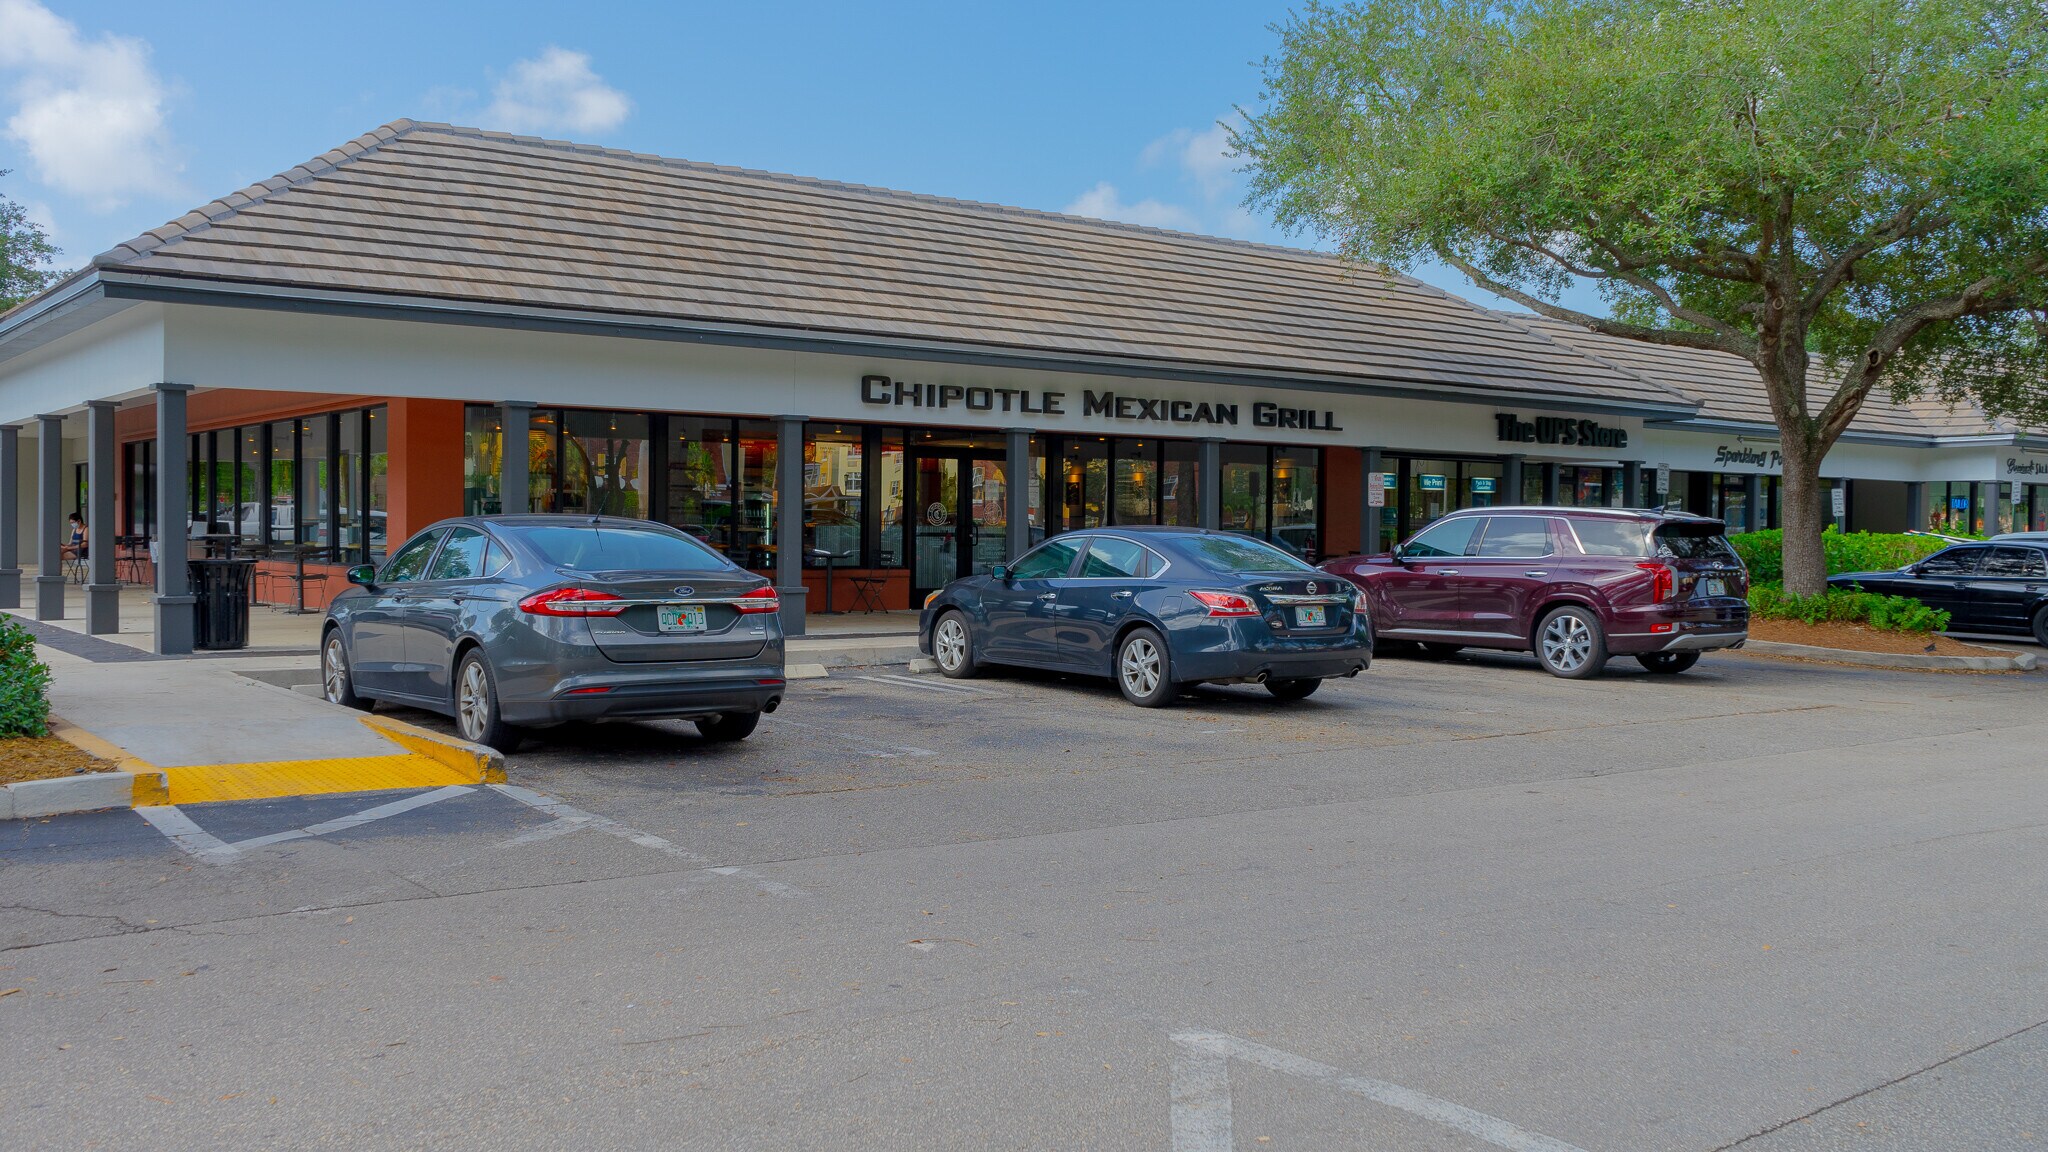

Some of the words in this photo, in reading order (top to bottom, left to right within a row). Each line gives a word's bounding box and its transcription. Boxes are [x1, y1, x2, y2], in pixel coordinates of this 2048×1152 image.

[861, 374, 1065, 415] CHIPOTLE
[1083, 389, 1239, 426] MEXICAN
[1252, 402, 1344, 432] GRILL
[1495, 413, 1536, 443] The
[1536, 416, 1578, 446] UPS
[1578, 419, 1628, 449] Store
[1714, 445, 1768, 468] Sparkling
[1423, 479, 1432, 487] We
[1432, 478, 1443, 487] Print
